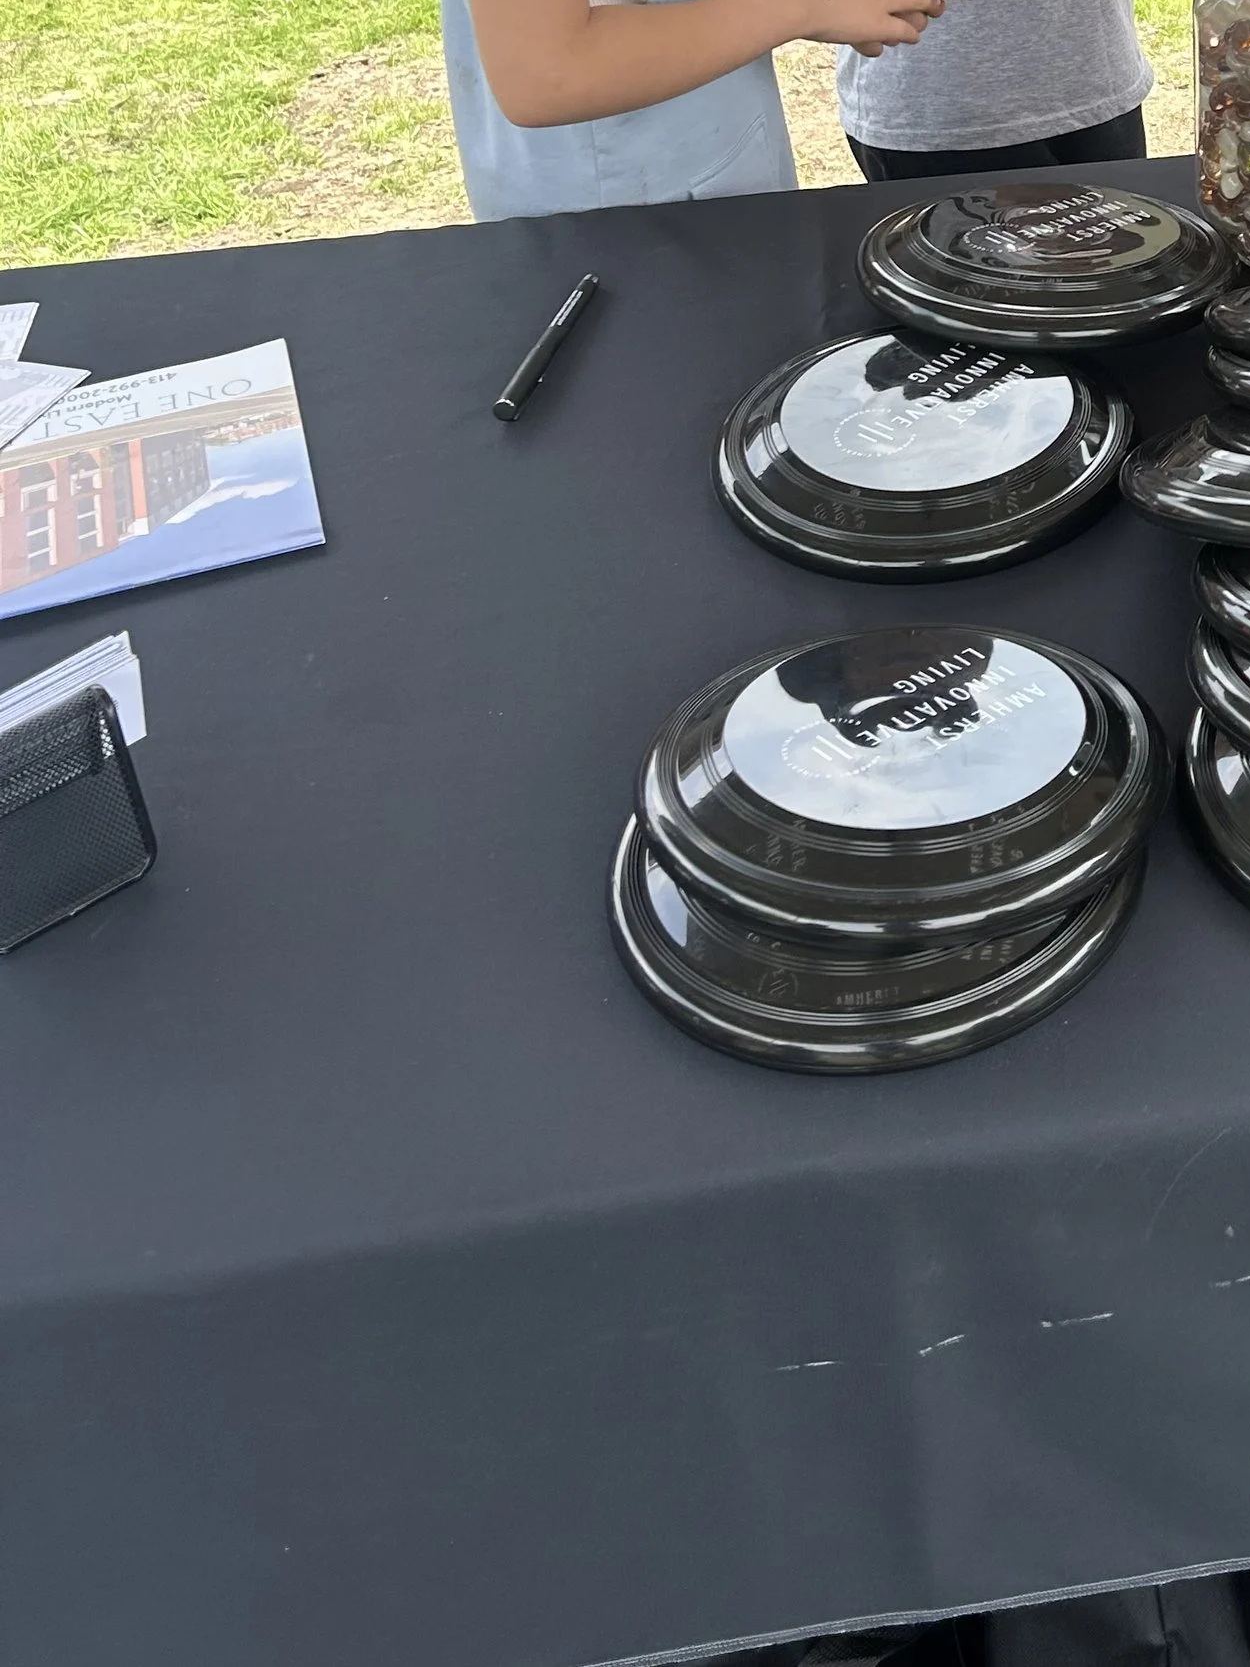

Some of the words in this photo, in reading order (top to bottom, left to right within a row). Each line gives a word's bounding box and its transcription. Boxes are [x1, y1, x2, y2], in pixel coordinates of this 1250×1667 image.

[1017, 200, 1128, 240] INNOVATIVE
[1041, 191, 1104, 214] LIVING
[1066, 209, 1152, 243] AMHERST
[66, 393, 133, 413] Modern
[158, 378, 252, 413] ONE
[891, 352, 1006, 429] INNOVATIVE
[947, 363, 1035, 426] AMHERST
[33, 402, 141, 442] EAST
[892, 647, 986, 695] LIVING
[855, 665, 1016, 748] INNOVATIVE
[926, 682, 1047, 751] AMHERST
